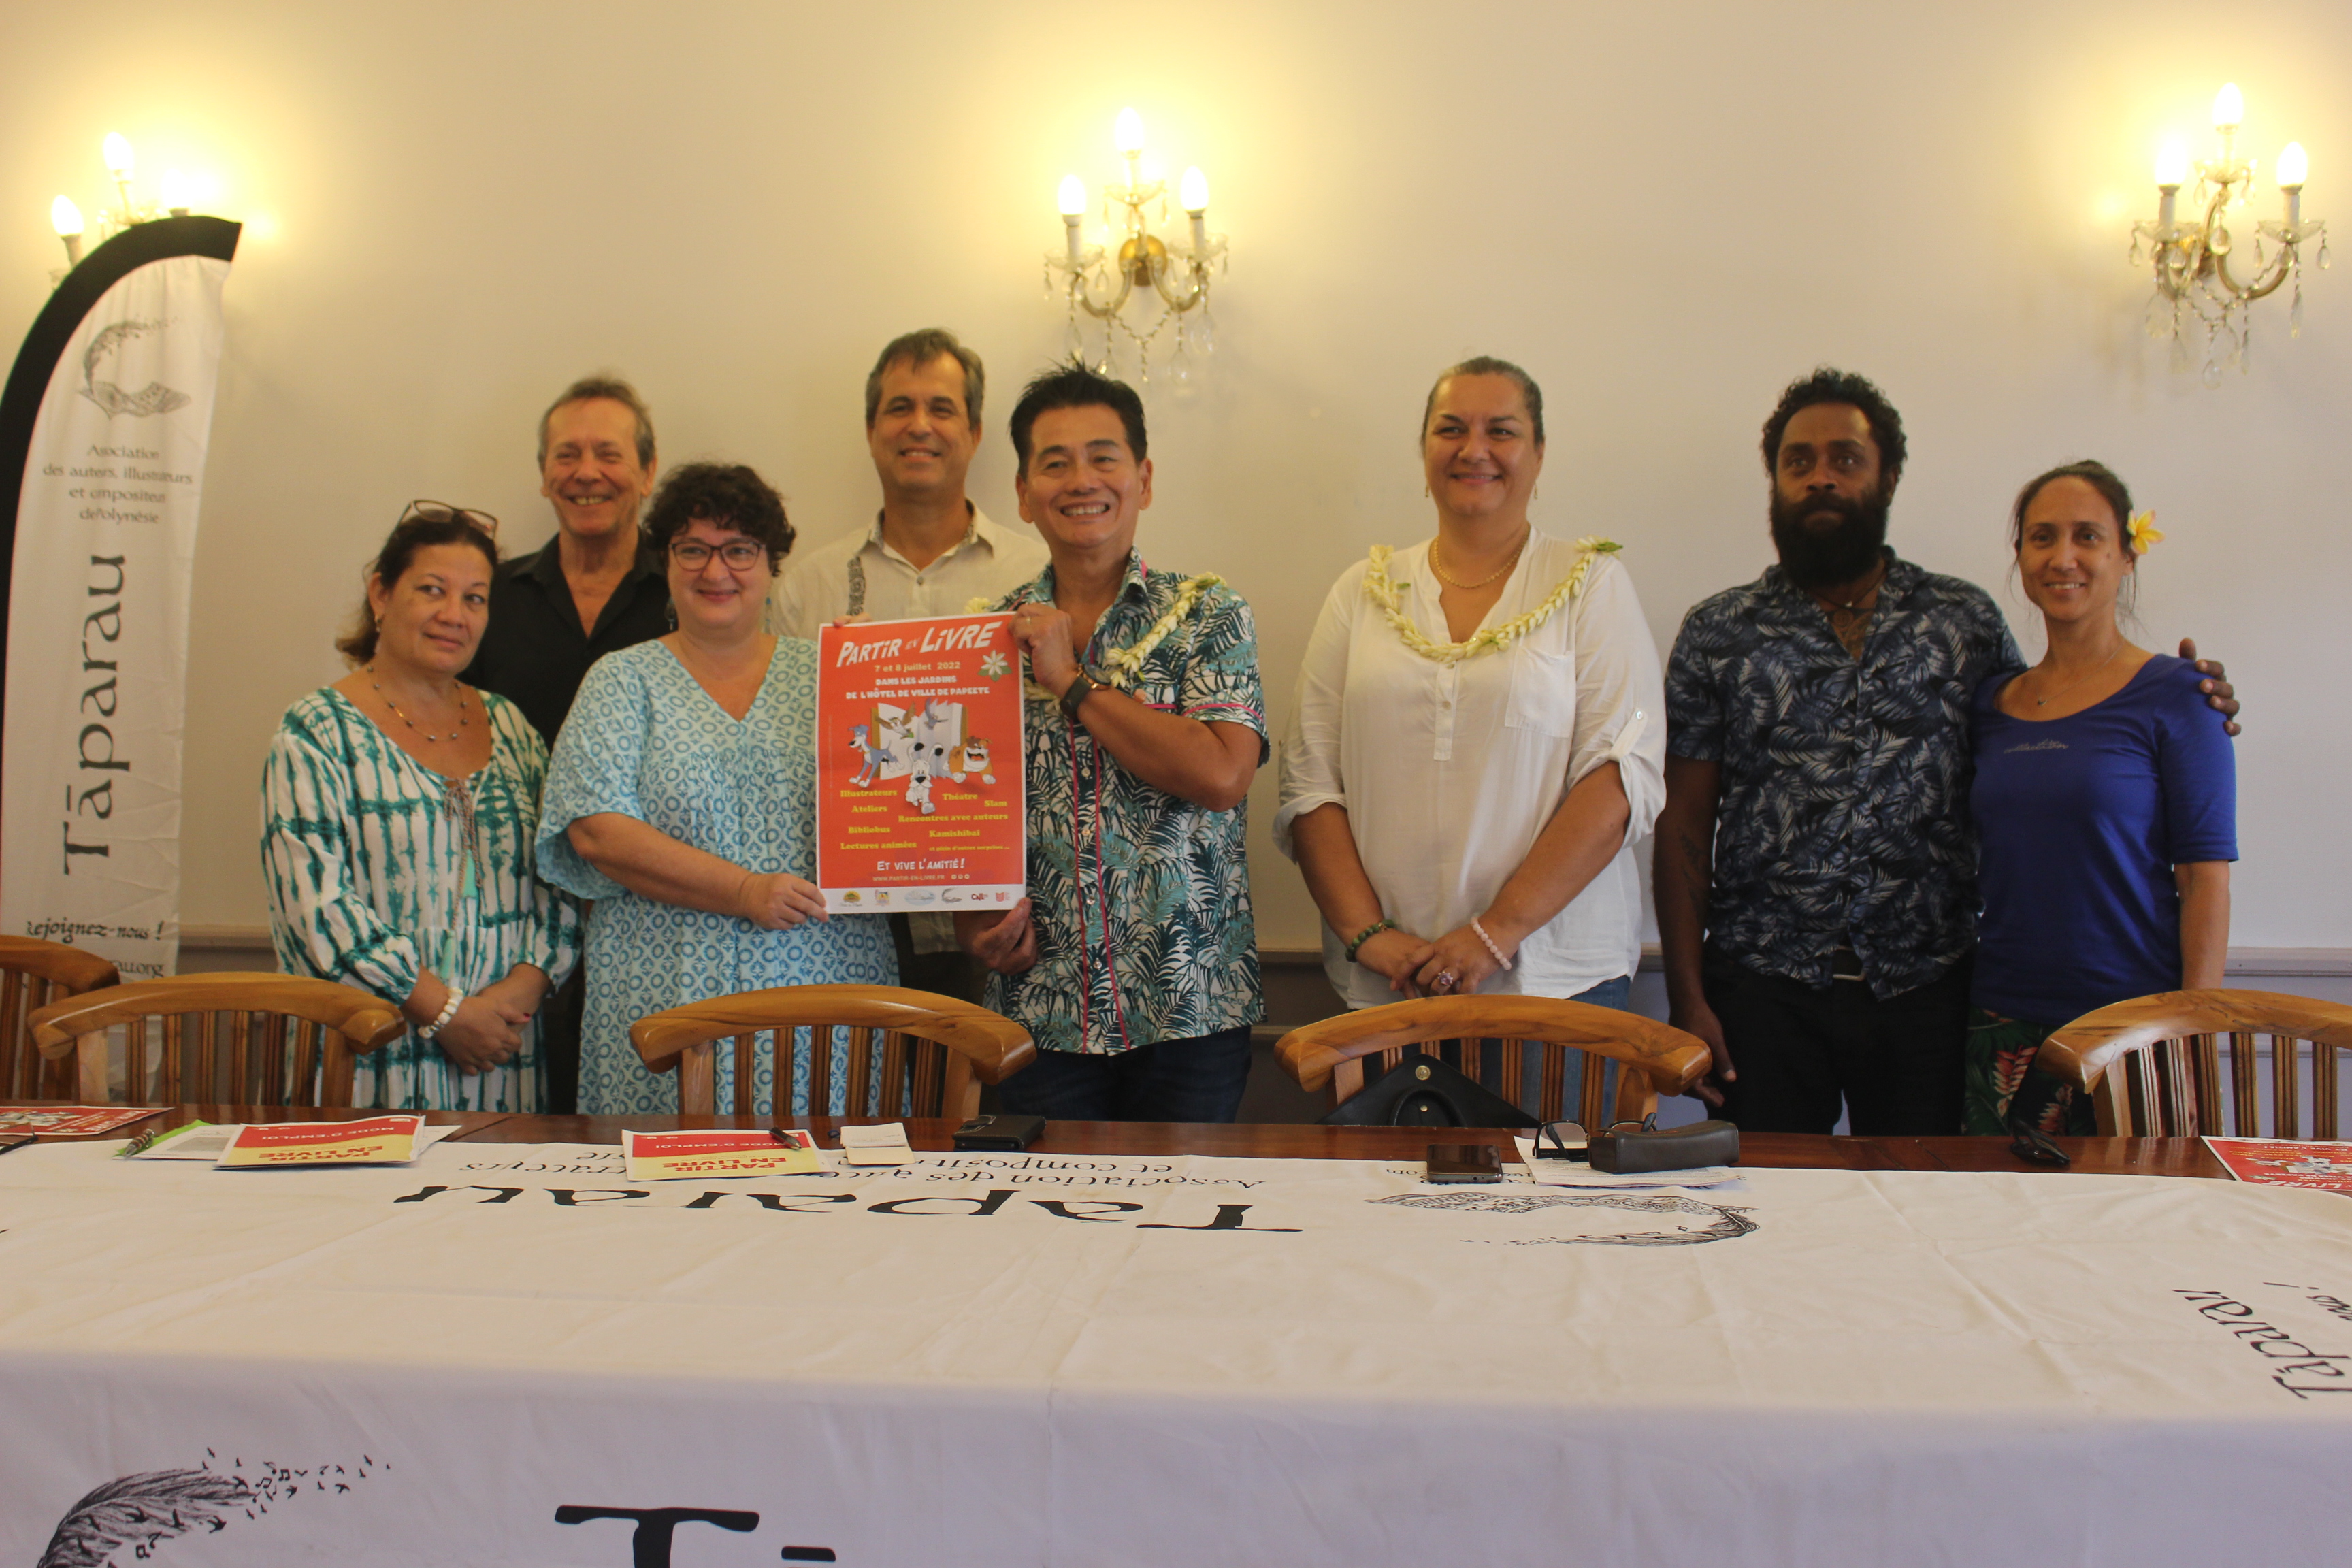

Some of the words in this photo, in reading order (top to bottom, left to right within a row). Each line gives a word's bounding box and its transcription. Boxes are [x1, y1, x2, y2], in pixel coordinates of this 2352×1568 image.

[69, 487, 85, 498] et
[903, 662, 932, 672] juillet
[937, 662, 960, 670] 2022
[875, 677, 899, 685] DANS
[900, 676, 916, 685] LES
[919, 676, 957, 684] JARDINS
[898, 689, 909, 698] DE
[911, 689, 936, 697] VILLE
[950, 687, 990, 696] PAPEETE
[840, 789, 898, 798] Illustrateurs
[898, 815, 949, 823] Rencontres
[848, 826, 891, 834] Bibliobus
[929, 829, 980, 838] Kamishibai
[840, 842, 879, 850] Lectures
[881, 840, 917, 849] animées
[262, 1132, 342, 1140] D'EMPLOI
[259, 1150, 337, 1158] LIVRE
[269, 1152, 370, 1162] PARTIR
[663, 1159, 740, 1168] LIVRE
[674, 1162, 775, 1172] PARTIR
[1128, 1163, 1173, 1173] et
[925, 1171, 994, 1183] des
[1011, 1175, 1266, 1189] Association
